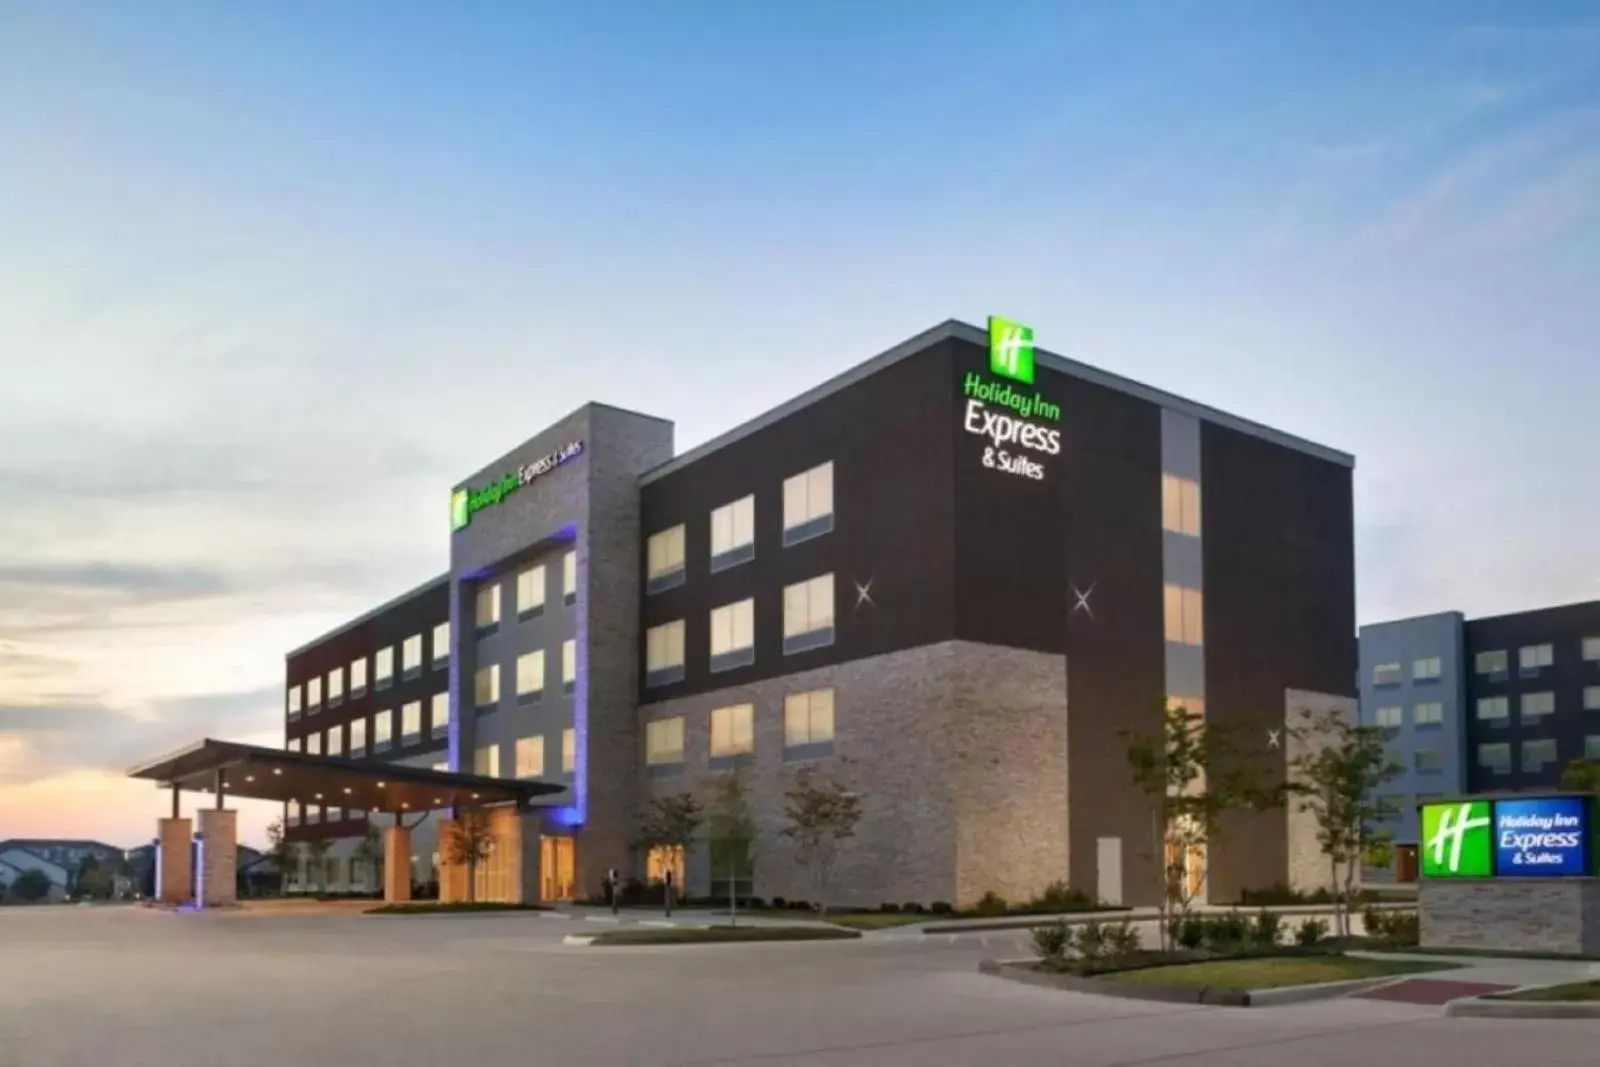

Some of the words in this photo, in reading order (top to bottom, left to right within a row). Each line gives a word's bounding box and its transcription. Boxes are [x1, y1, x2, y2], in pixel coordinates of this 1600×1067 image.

[964, 372, 1032, 417] Holiday
[1033, 392, 1060, 420] Inn
[964, 399, 1061, 455] Express
[982, 447, 995, 468] &
[997, 450, 1044, 480] Suites
[1500, 815, 1552, 829] Holiday
[1553, 813, 1579, 827] Inn
[1500, 831, 1581, 852] Express
[1512, 853, 1522, 864] &
[1525, 853, 1563, 864] Suites
